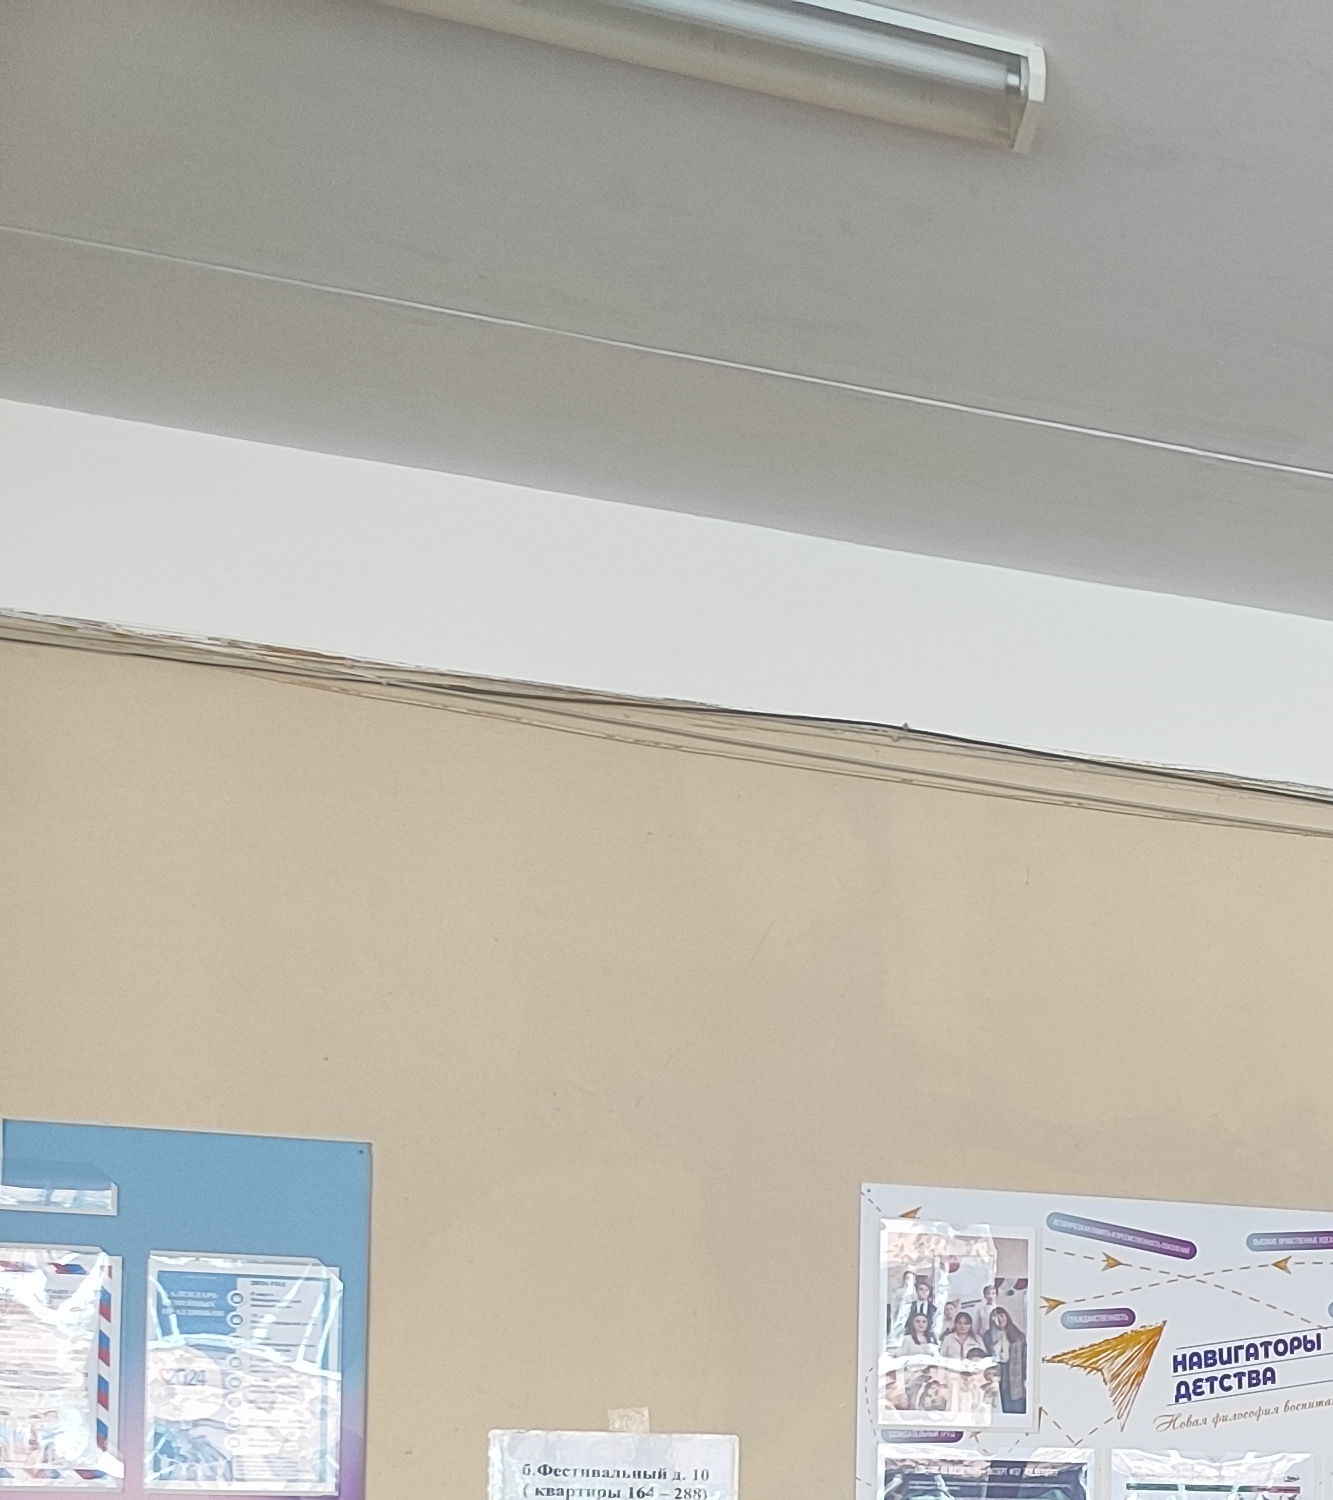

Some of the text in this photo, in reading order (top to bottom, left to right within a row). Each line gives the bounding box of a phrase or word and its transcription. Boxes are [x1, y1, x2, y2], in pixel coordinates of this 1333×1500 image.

[1172, 1332, 1322, 1373] НАВИГАТОРЫ
[1175, 1366, 1277, 1403] ДЕТСТВА
[1153, 1412, 1207, 1433] Новая
[1212, 1406, 1279, 1428] философия
[522, 1463, 710, 1481] б.Фестивальный д. 10
[534, 1486, 621, 1500] квартиры
[628, 1486, 654, 1499] 164
